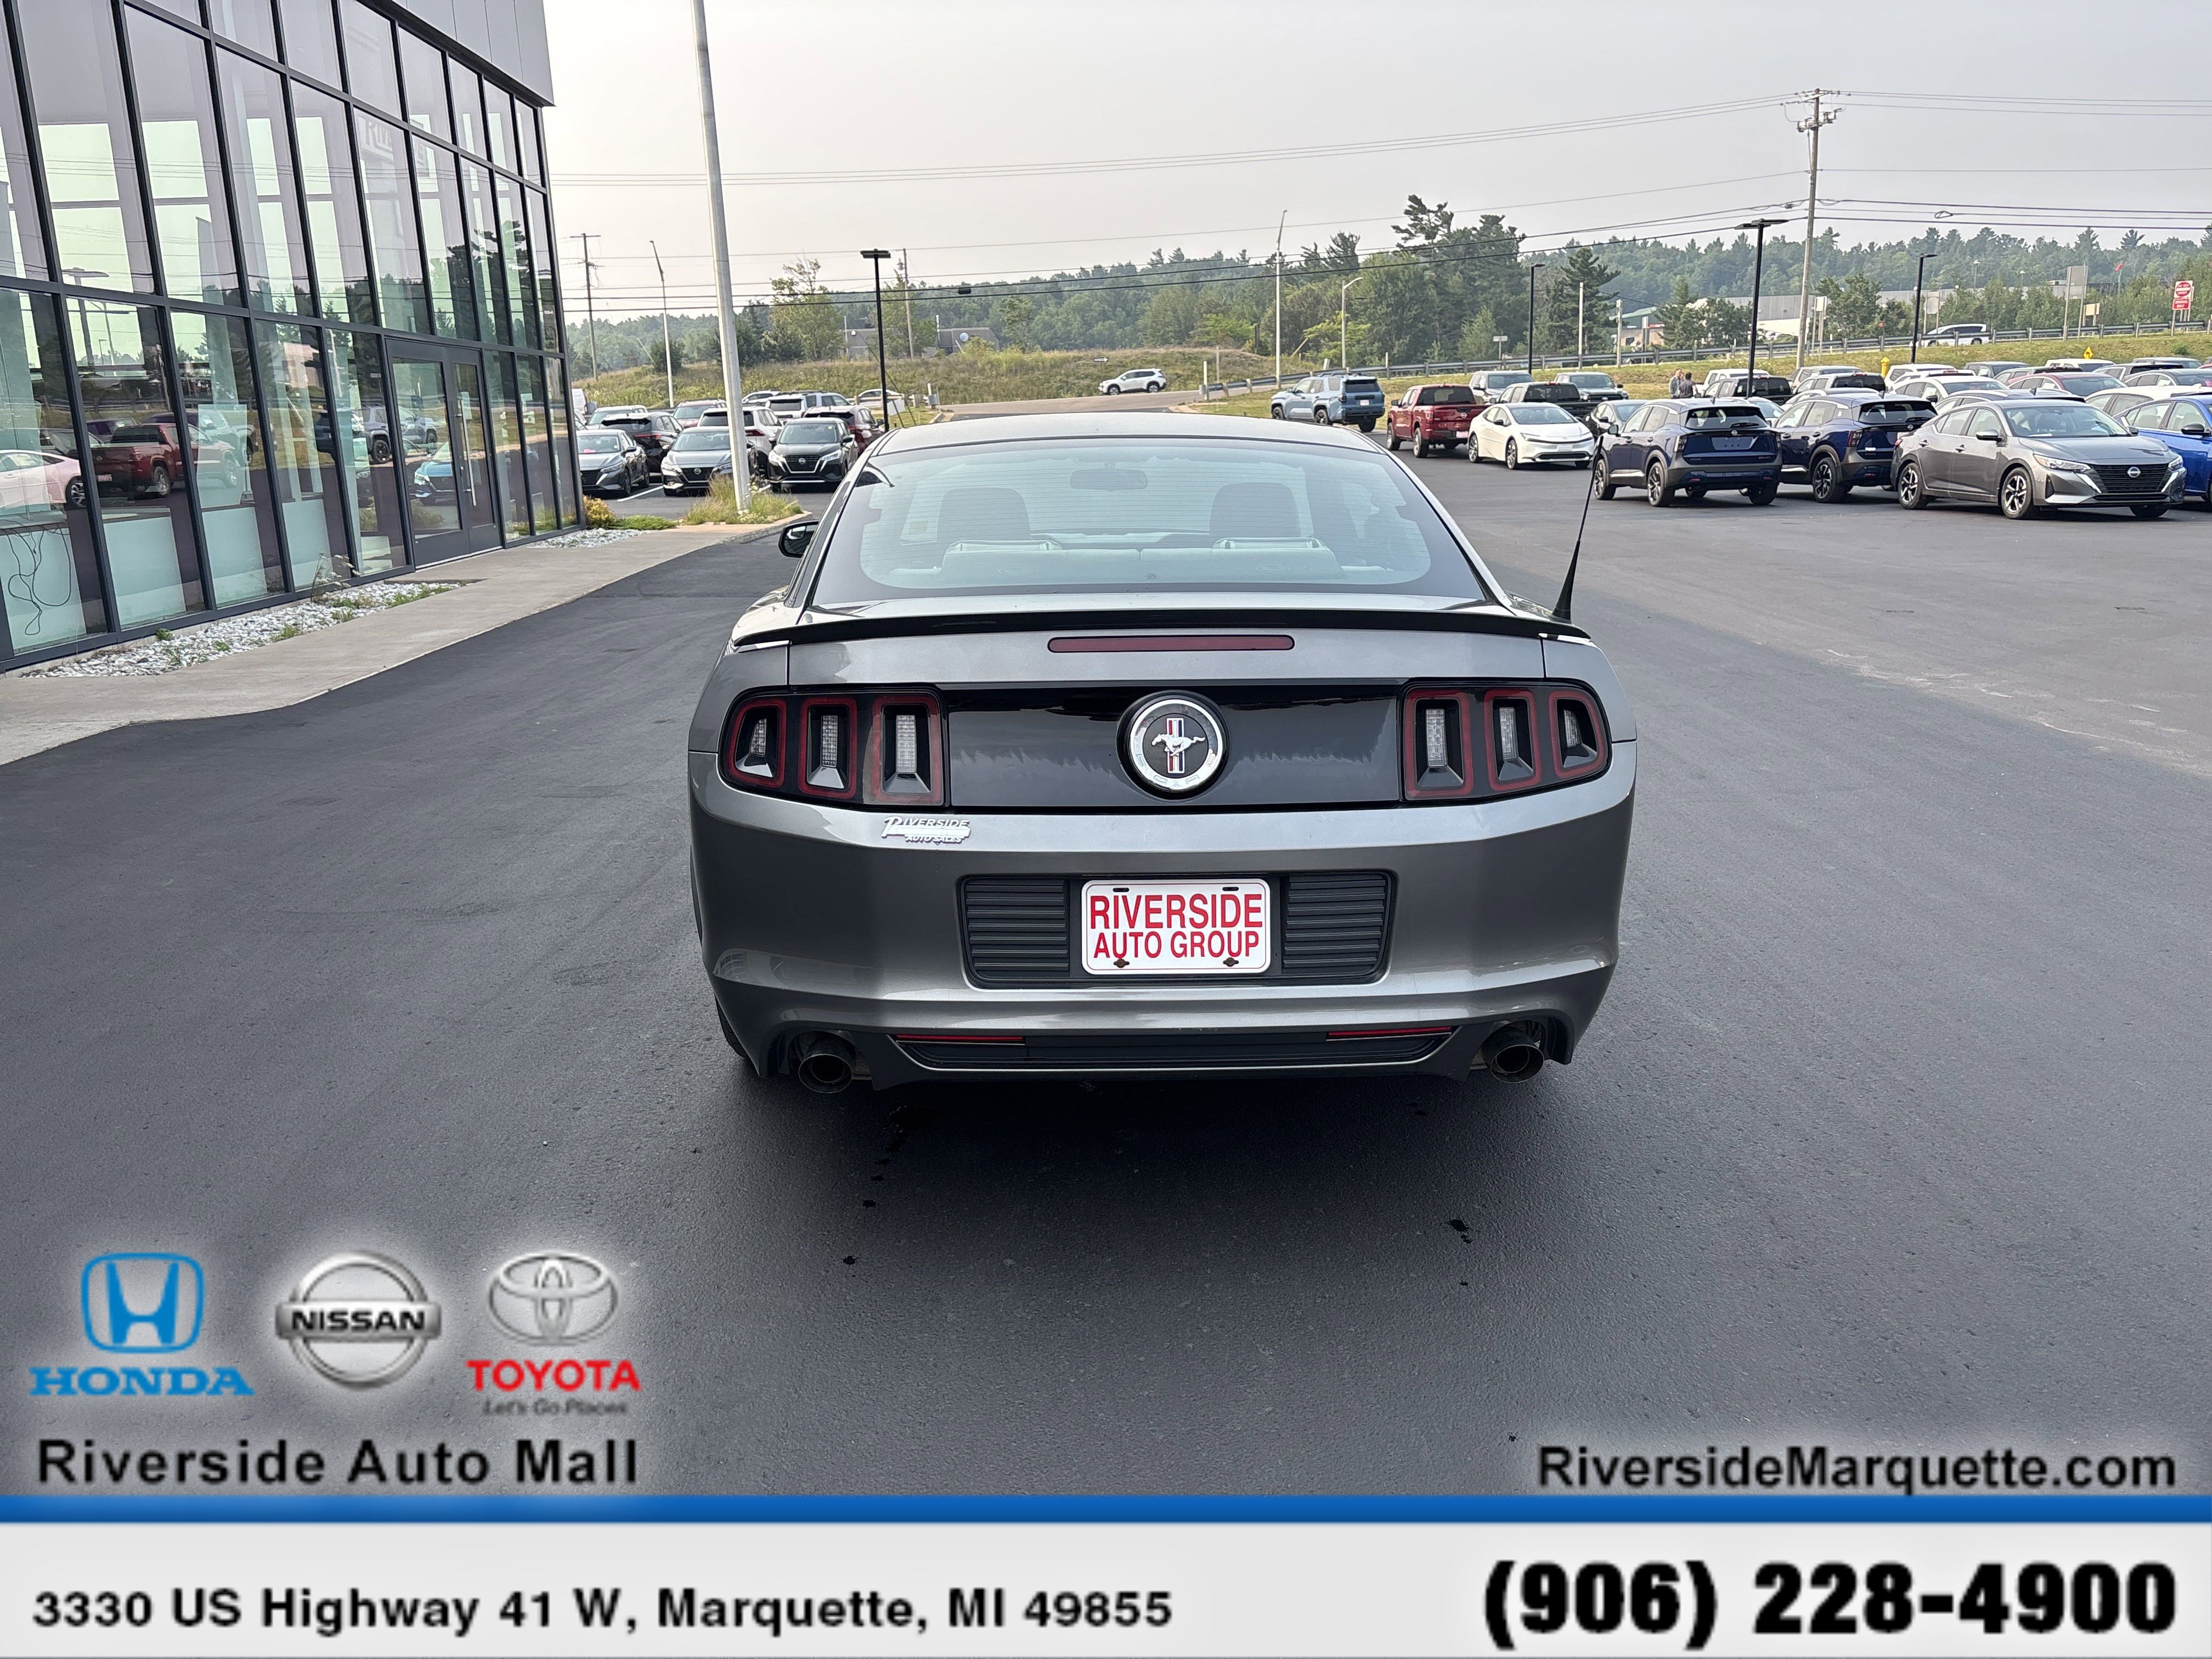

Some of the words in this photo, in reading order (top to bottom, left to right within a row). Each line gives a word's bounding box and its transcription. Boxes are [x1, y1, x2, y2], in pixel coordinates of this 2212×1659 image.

[881, 816, 970, 838] RIVERSIDE
[1090, 893, 1262, 929] RIVERSIDE
[1093, 931, 1162, 958] AUTO
[1170, 930, 1259, 957] GROUP
